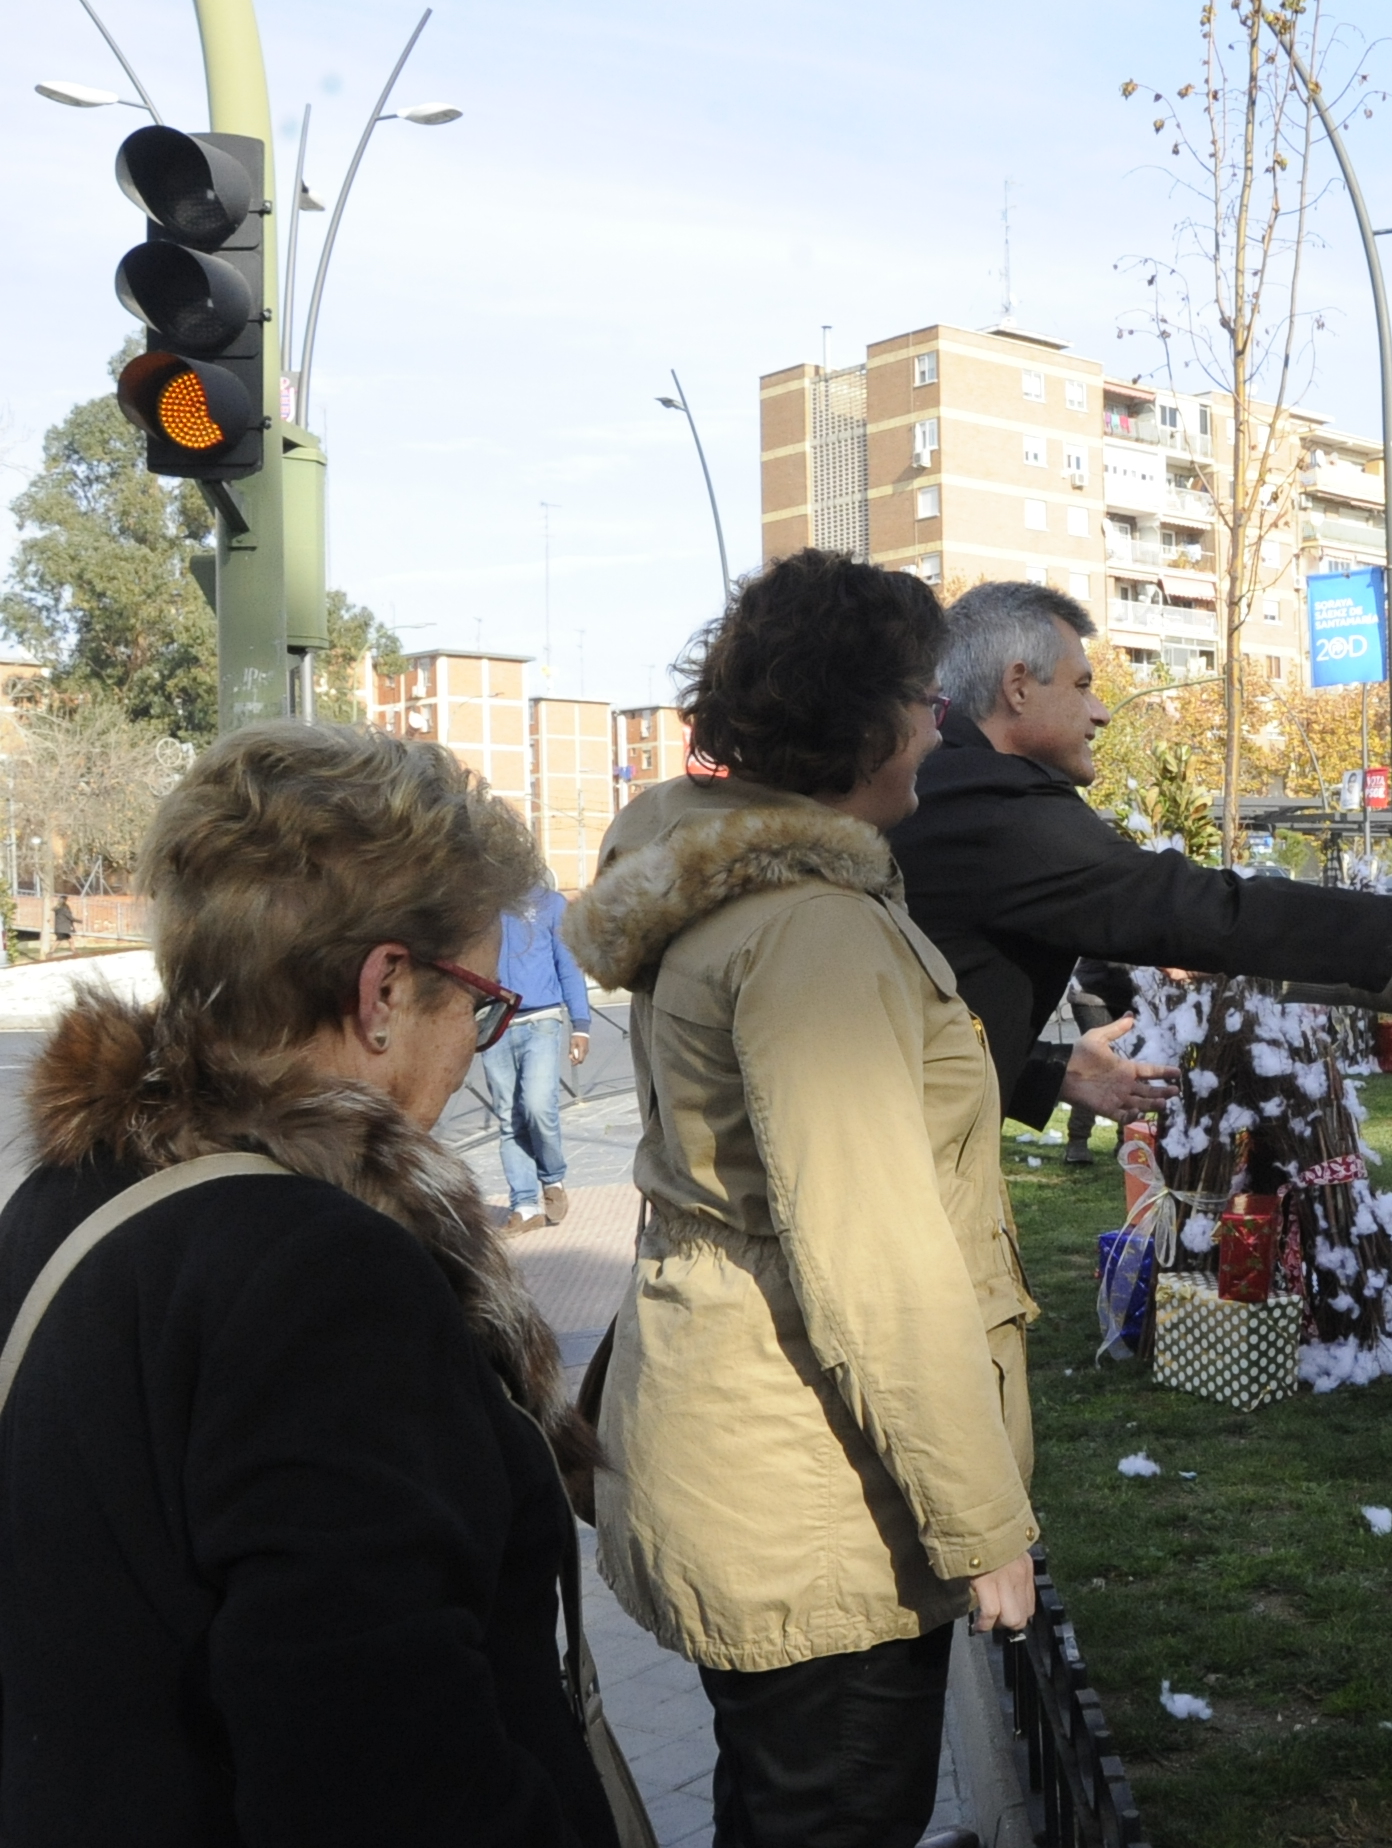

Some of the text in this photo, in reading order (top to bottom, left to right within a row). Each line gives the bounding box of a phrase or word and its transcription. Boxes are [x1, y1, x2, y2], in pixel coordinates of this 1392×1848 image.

[1314, 598, 1354, 610] SORAYA
[1349, 605, 1363, 616] DE
[1315, 613, 1379, 630] SANTAMARÍA
